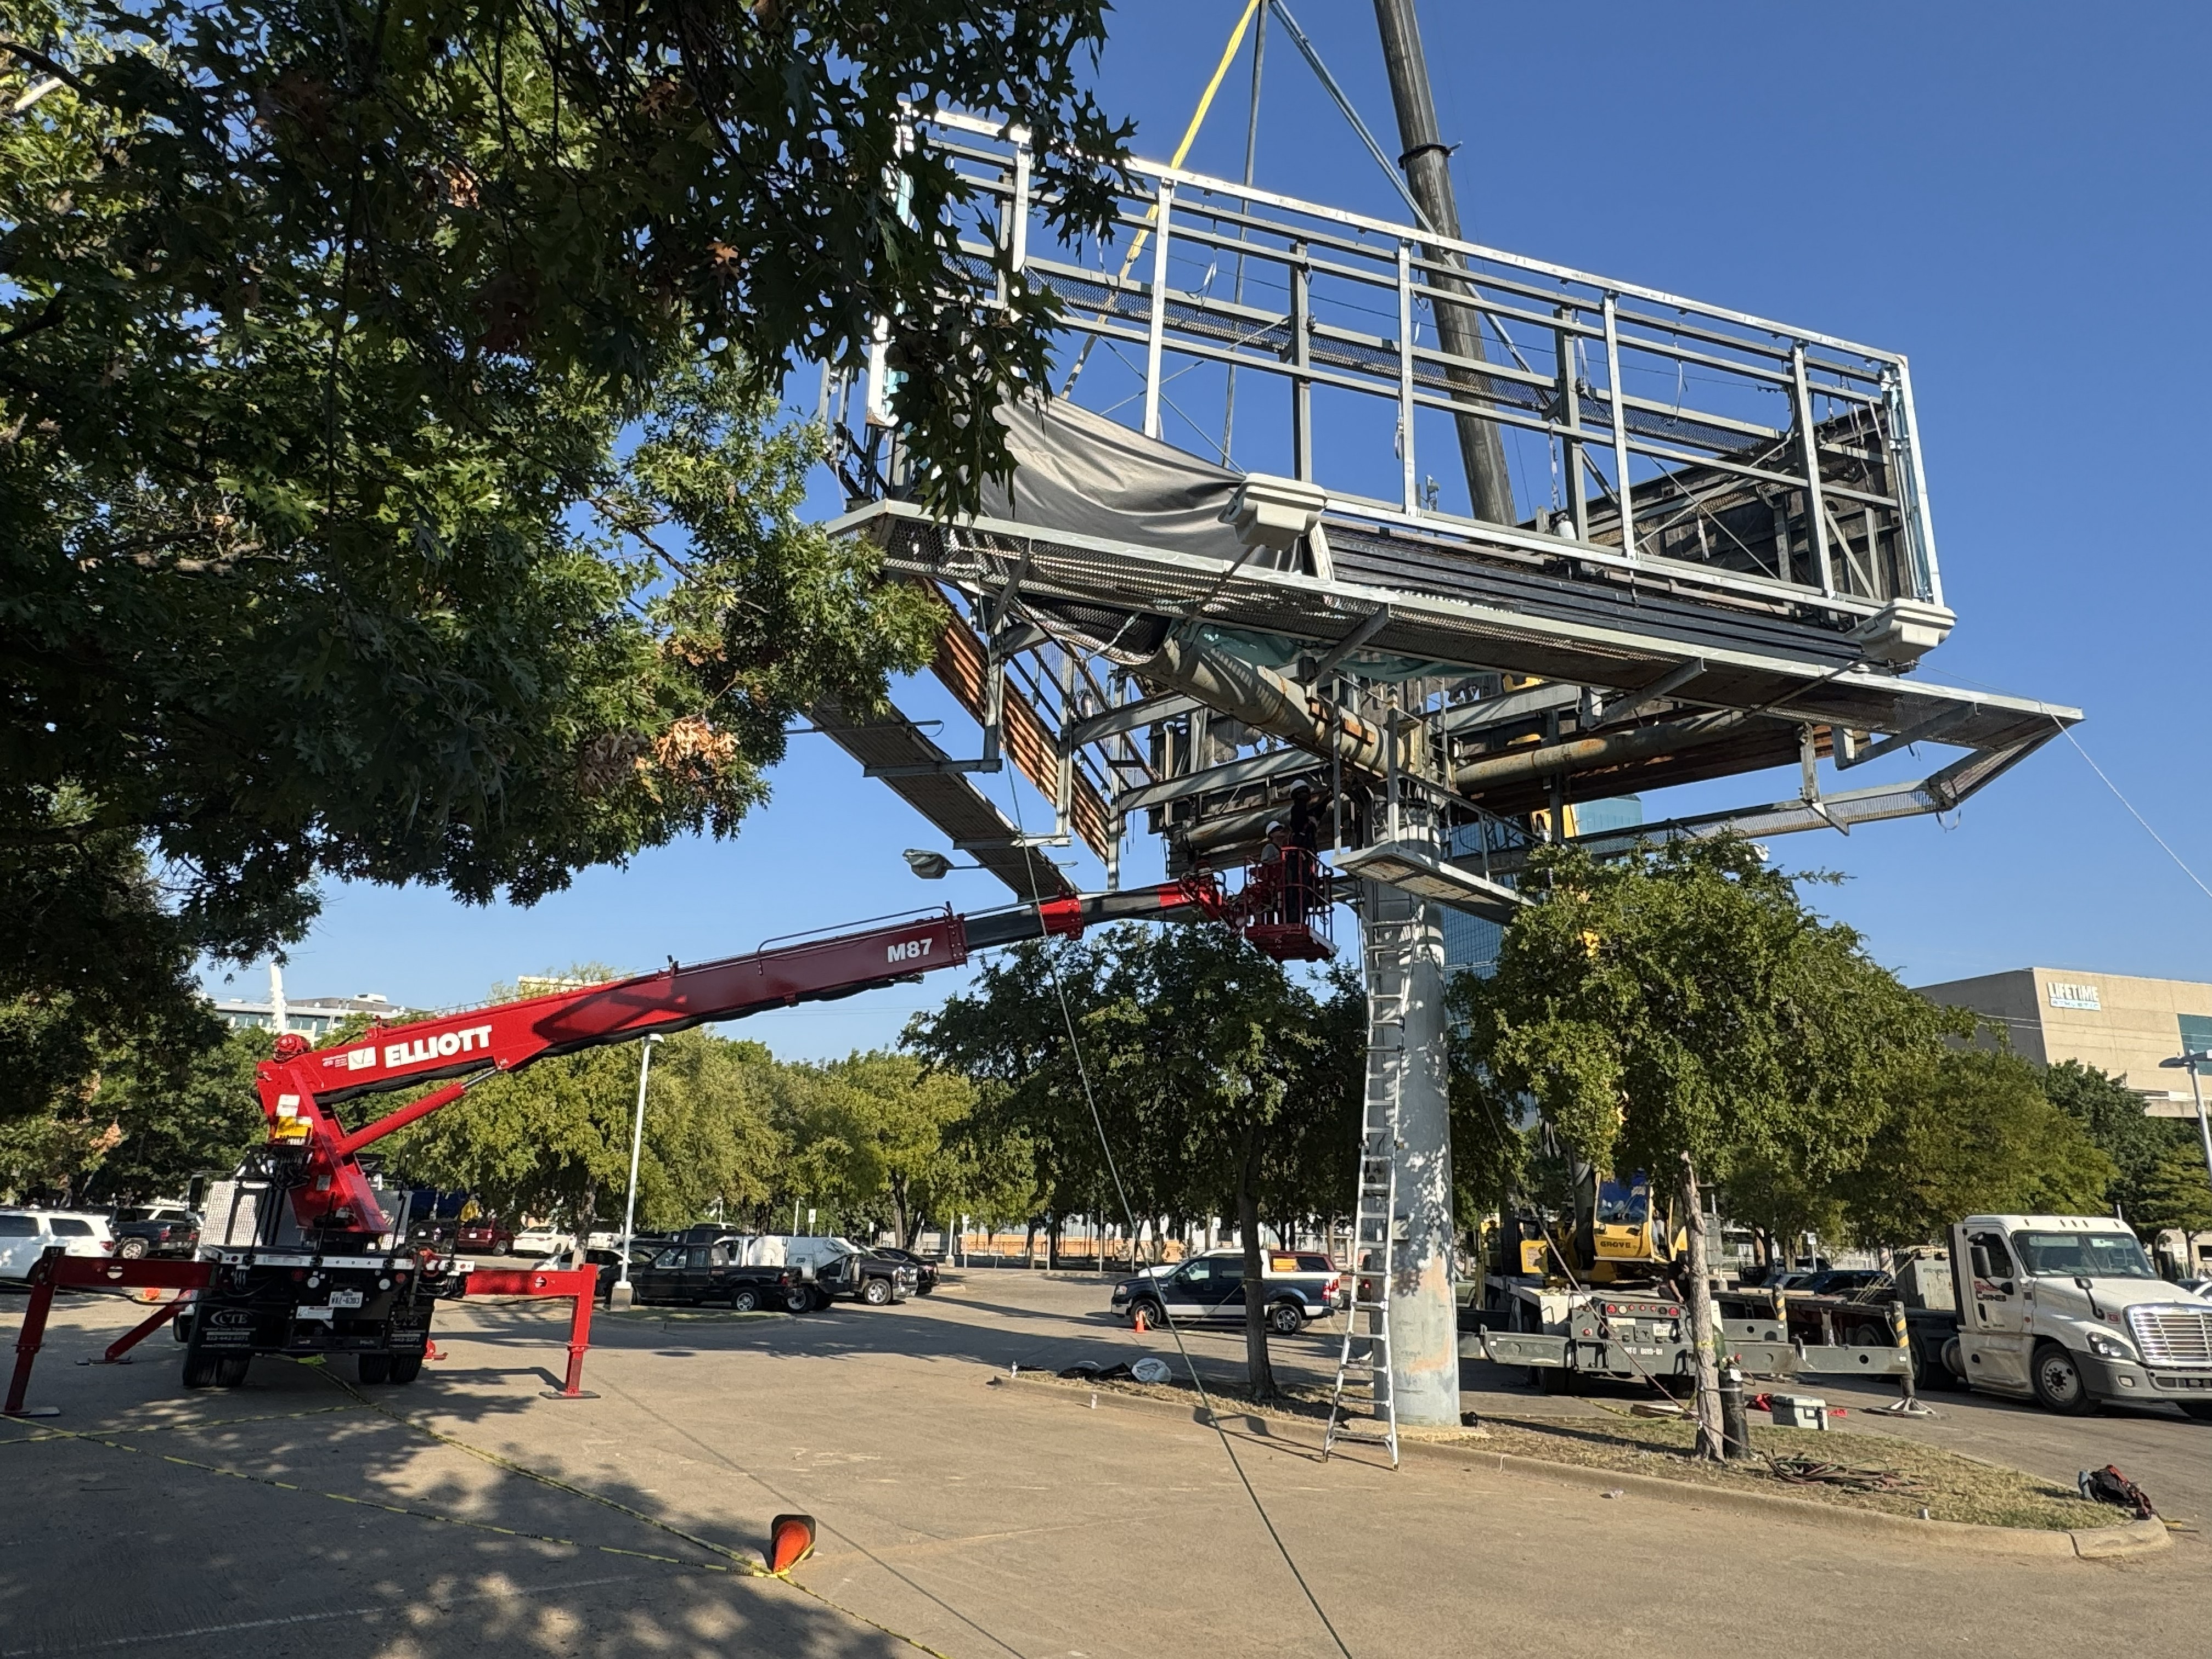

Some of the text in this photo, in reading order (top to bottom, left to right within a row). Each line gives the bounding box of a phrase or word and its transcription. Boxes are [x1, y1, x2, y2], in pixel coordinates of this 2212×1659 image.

[888, 938, 933, 963] M87
[2047, 982, 2099, 1002] LIFETIME
[385, 1025, 493, 1068] ELLIOTT
[219, 1313, 249, 1324] CTE
